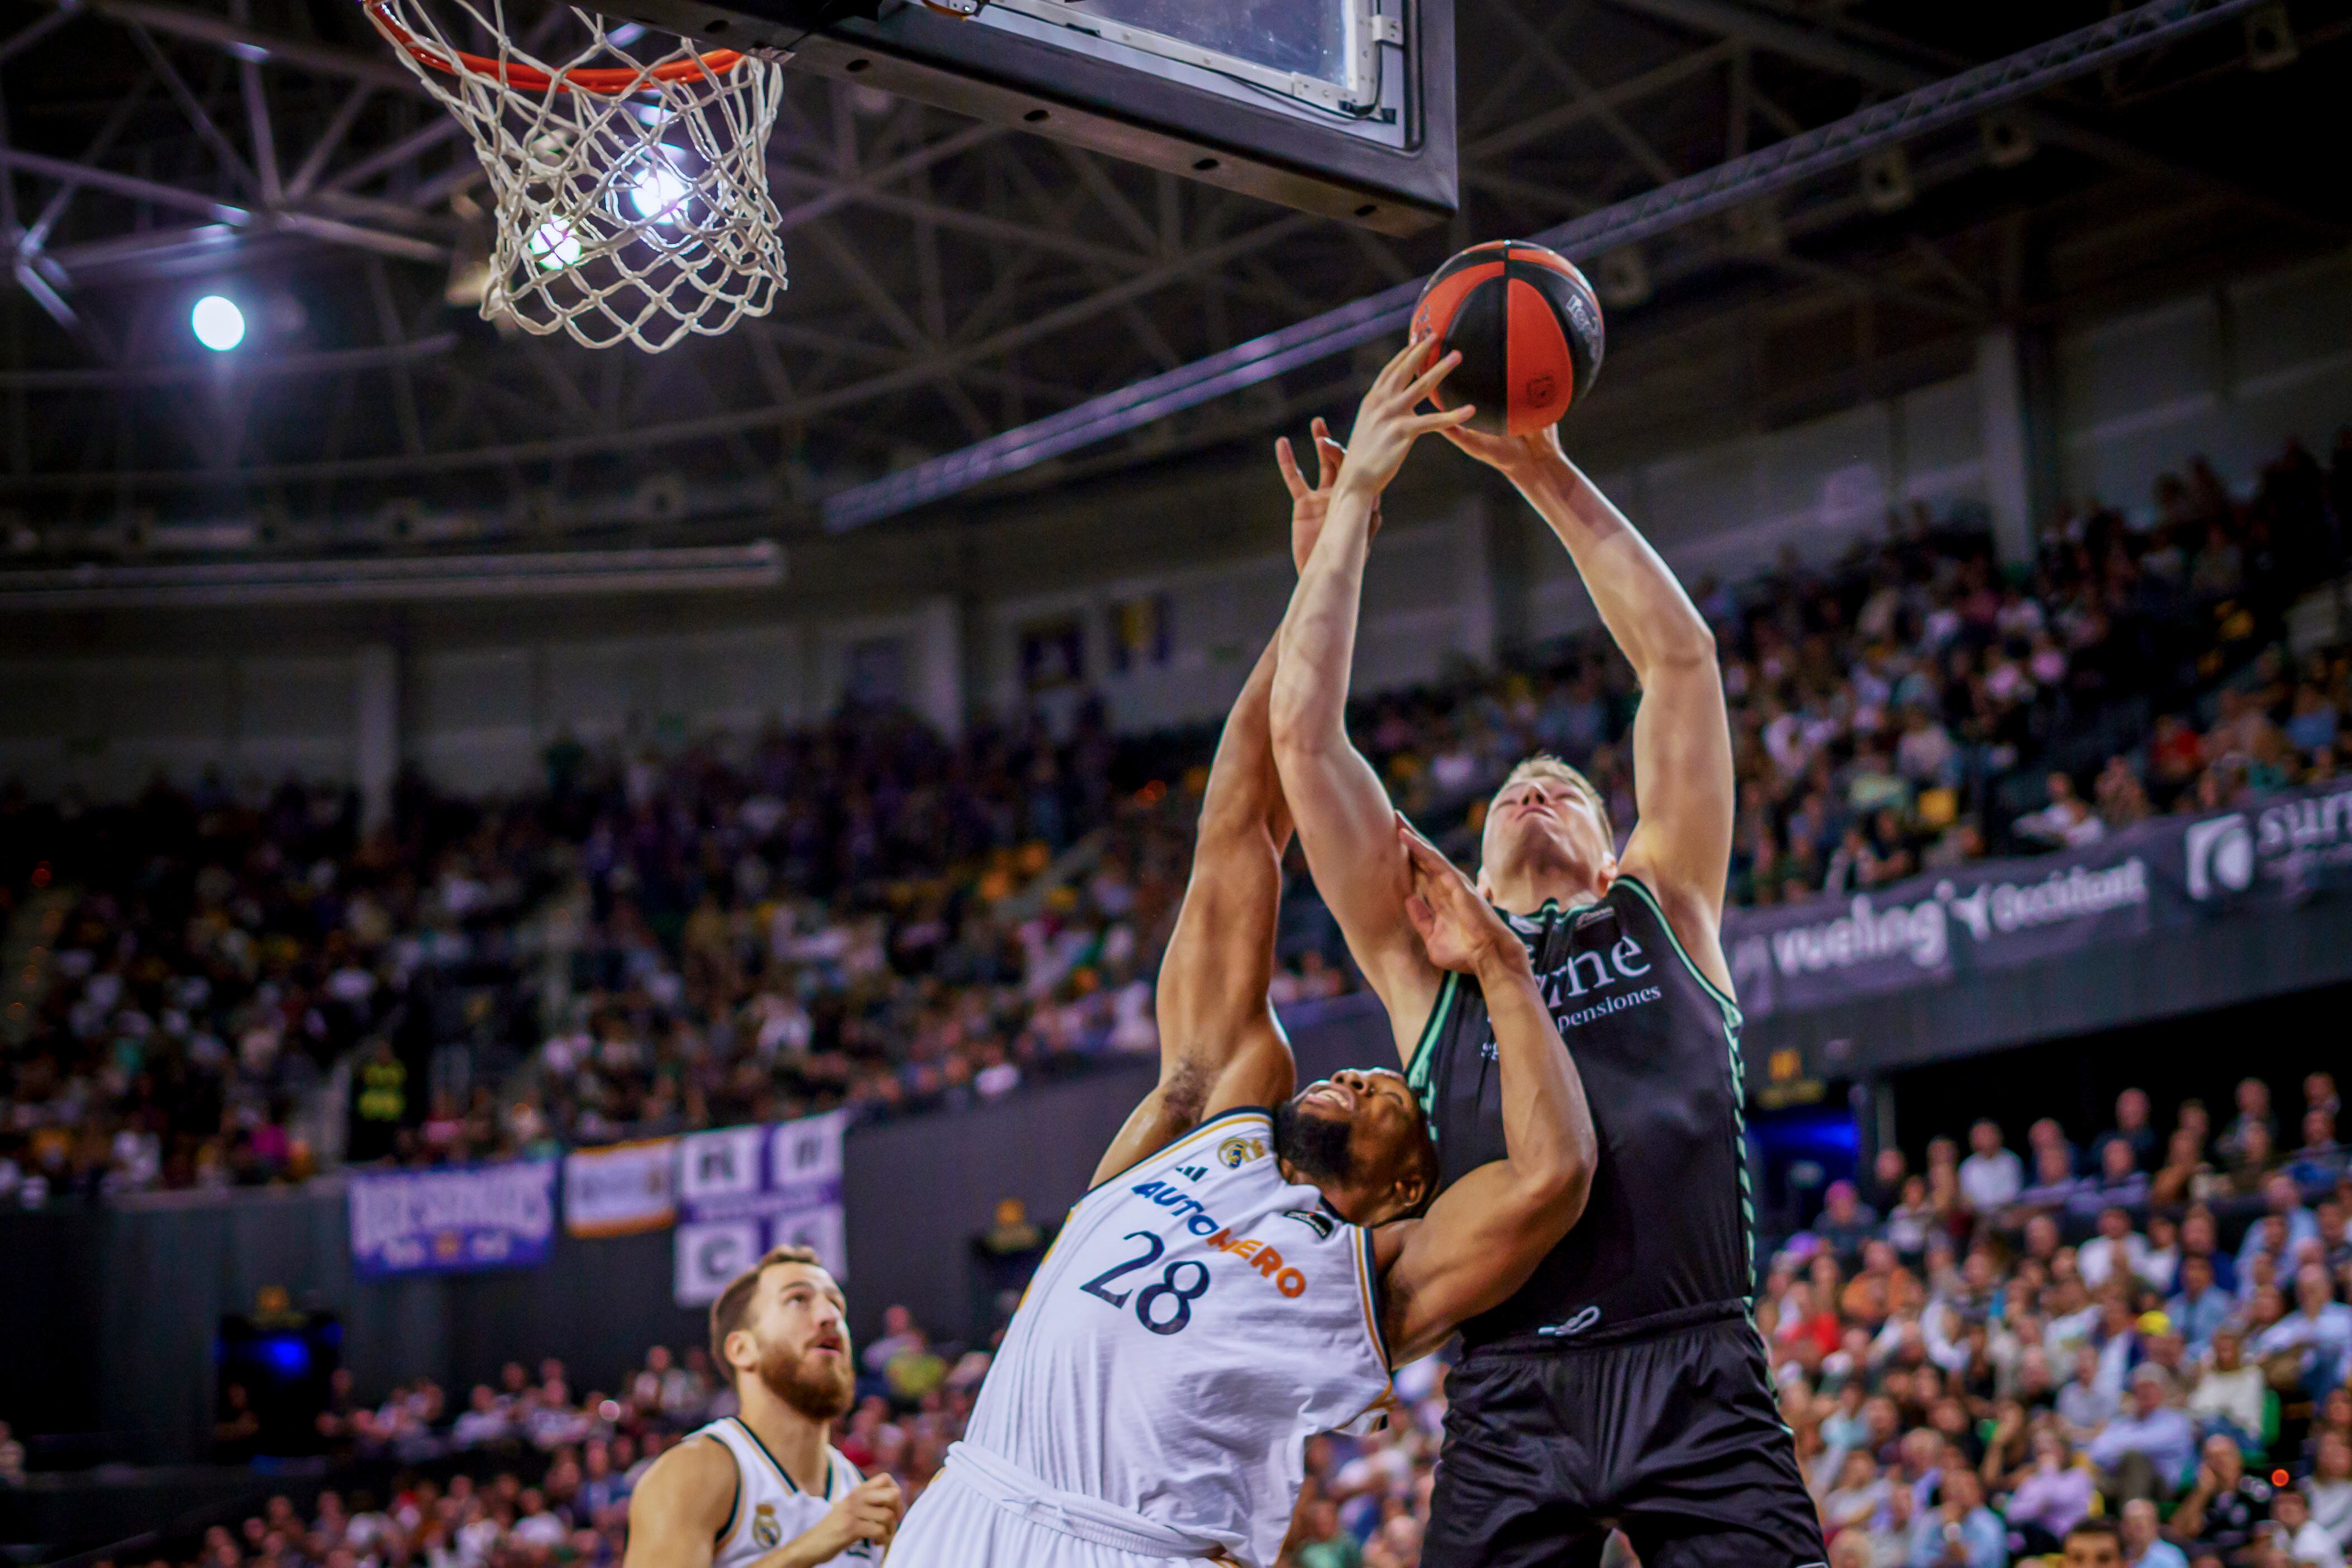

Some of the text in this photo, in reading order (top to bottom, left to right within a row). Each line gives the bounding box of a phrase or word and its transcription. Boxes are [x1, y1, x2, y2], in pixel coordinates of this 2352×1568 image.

[1772, 894, 1948, 975] vueling
[1558, 985, 1662, 1033] pensiones
[1131, 1170, 1306, 1298] AUTOHERO
[1079, 1231, 1210, 1335] 28
